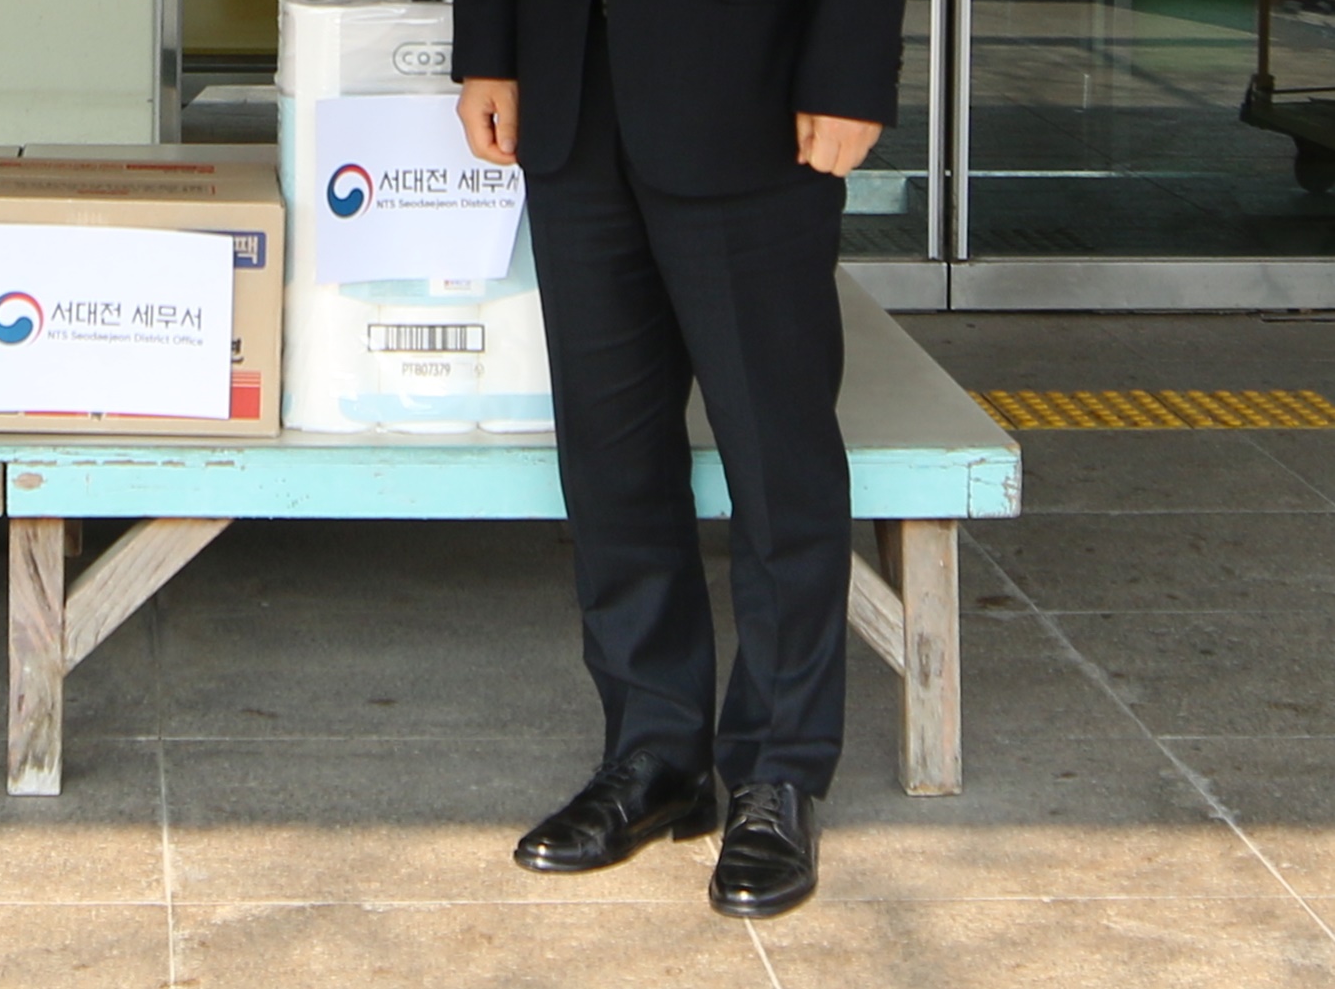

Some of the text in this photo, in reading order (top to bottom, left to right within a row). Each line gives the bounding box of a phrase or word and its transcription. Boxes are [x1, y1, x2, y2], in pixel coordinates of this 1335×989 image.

[379, 169, 448, 193] 서대전
[376, 199, 396, 209] NTS
[399, 199, 458, 210] Seodaejeon
[461, 199, 496, 208] District
[51, 301, 202, 331] 서대전 세무서
[47, 331, 68, 340] NTS
[134, 333, 170, 344] District
[173, 336, 203, 346] Office
